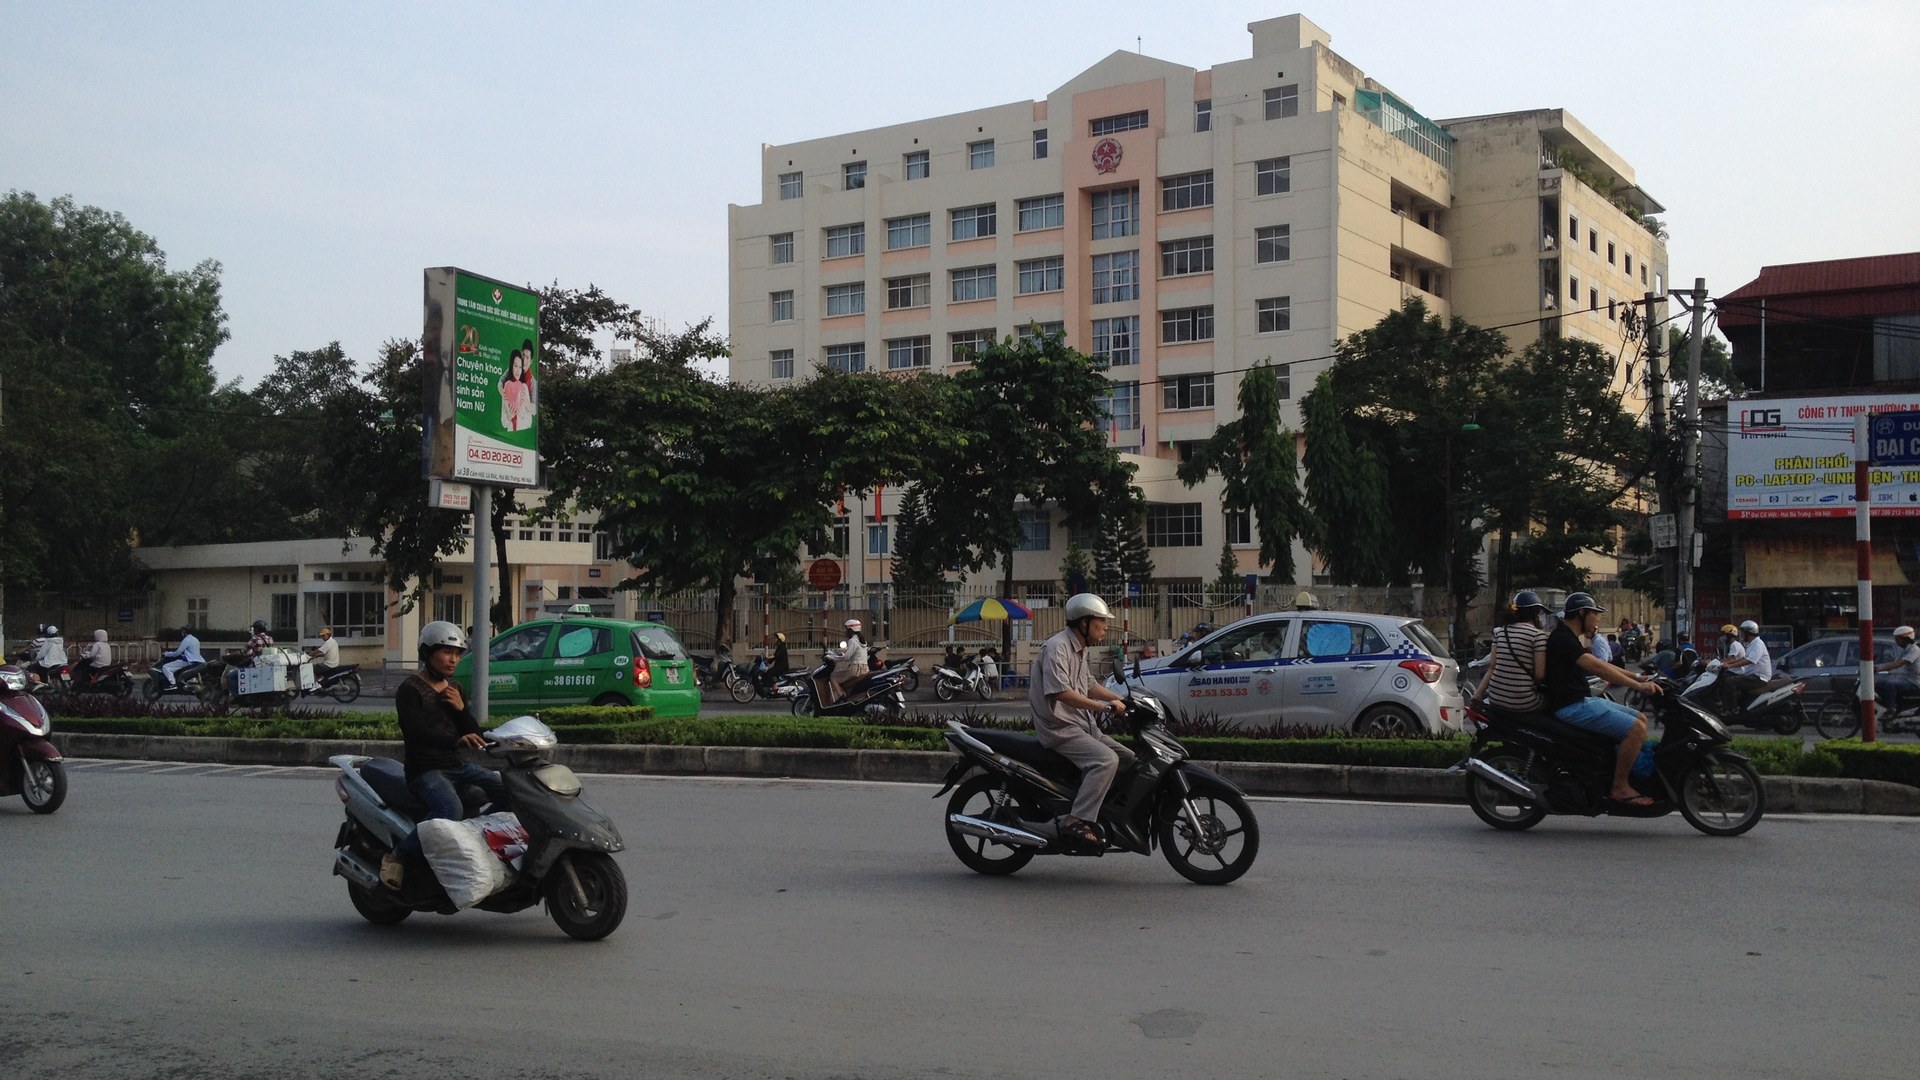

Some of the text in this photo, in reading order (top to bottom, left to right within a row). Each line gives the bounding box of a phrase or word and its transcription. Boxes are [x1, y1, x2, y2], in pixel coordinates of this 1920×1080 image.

[457, 356, 503, 375] Chuyên khoa
[457, 371, 489, 386] sức khỏe
[456, 385, 485, 398] sinh sản
[456, 398, 486, 412] Nam Nữ
[1798, 405, 1824, 419] CÔNG
[1827, 406, 1838, 418] TY
[1876, 438, 1905, 459] ĐẠI
[481, 450, 491, 460] 20
[491, 452, 502, 462] 20
[502, 453, 512, 463] 20
[512, 454, 522, 464] 20
[1775, 456, 1814, 470] PHÂN
[1815, 453, 1849, 469] PHỐI
[1736, 475, 1755, 487] PC
[1764, 473, 1815, 487] LAPTOP
[1824, 472, 1856, 485] LINH
[1868, 469, 1892, 486] IỆN
